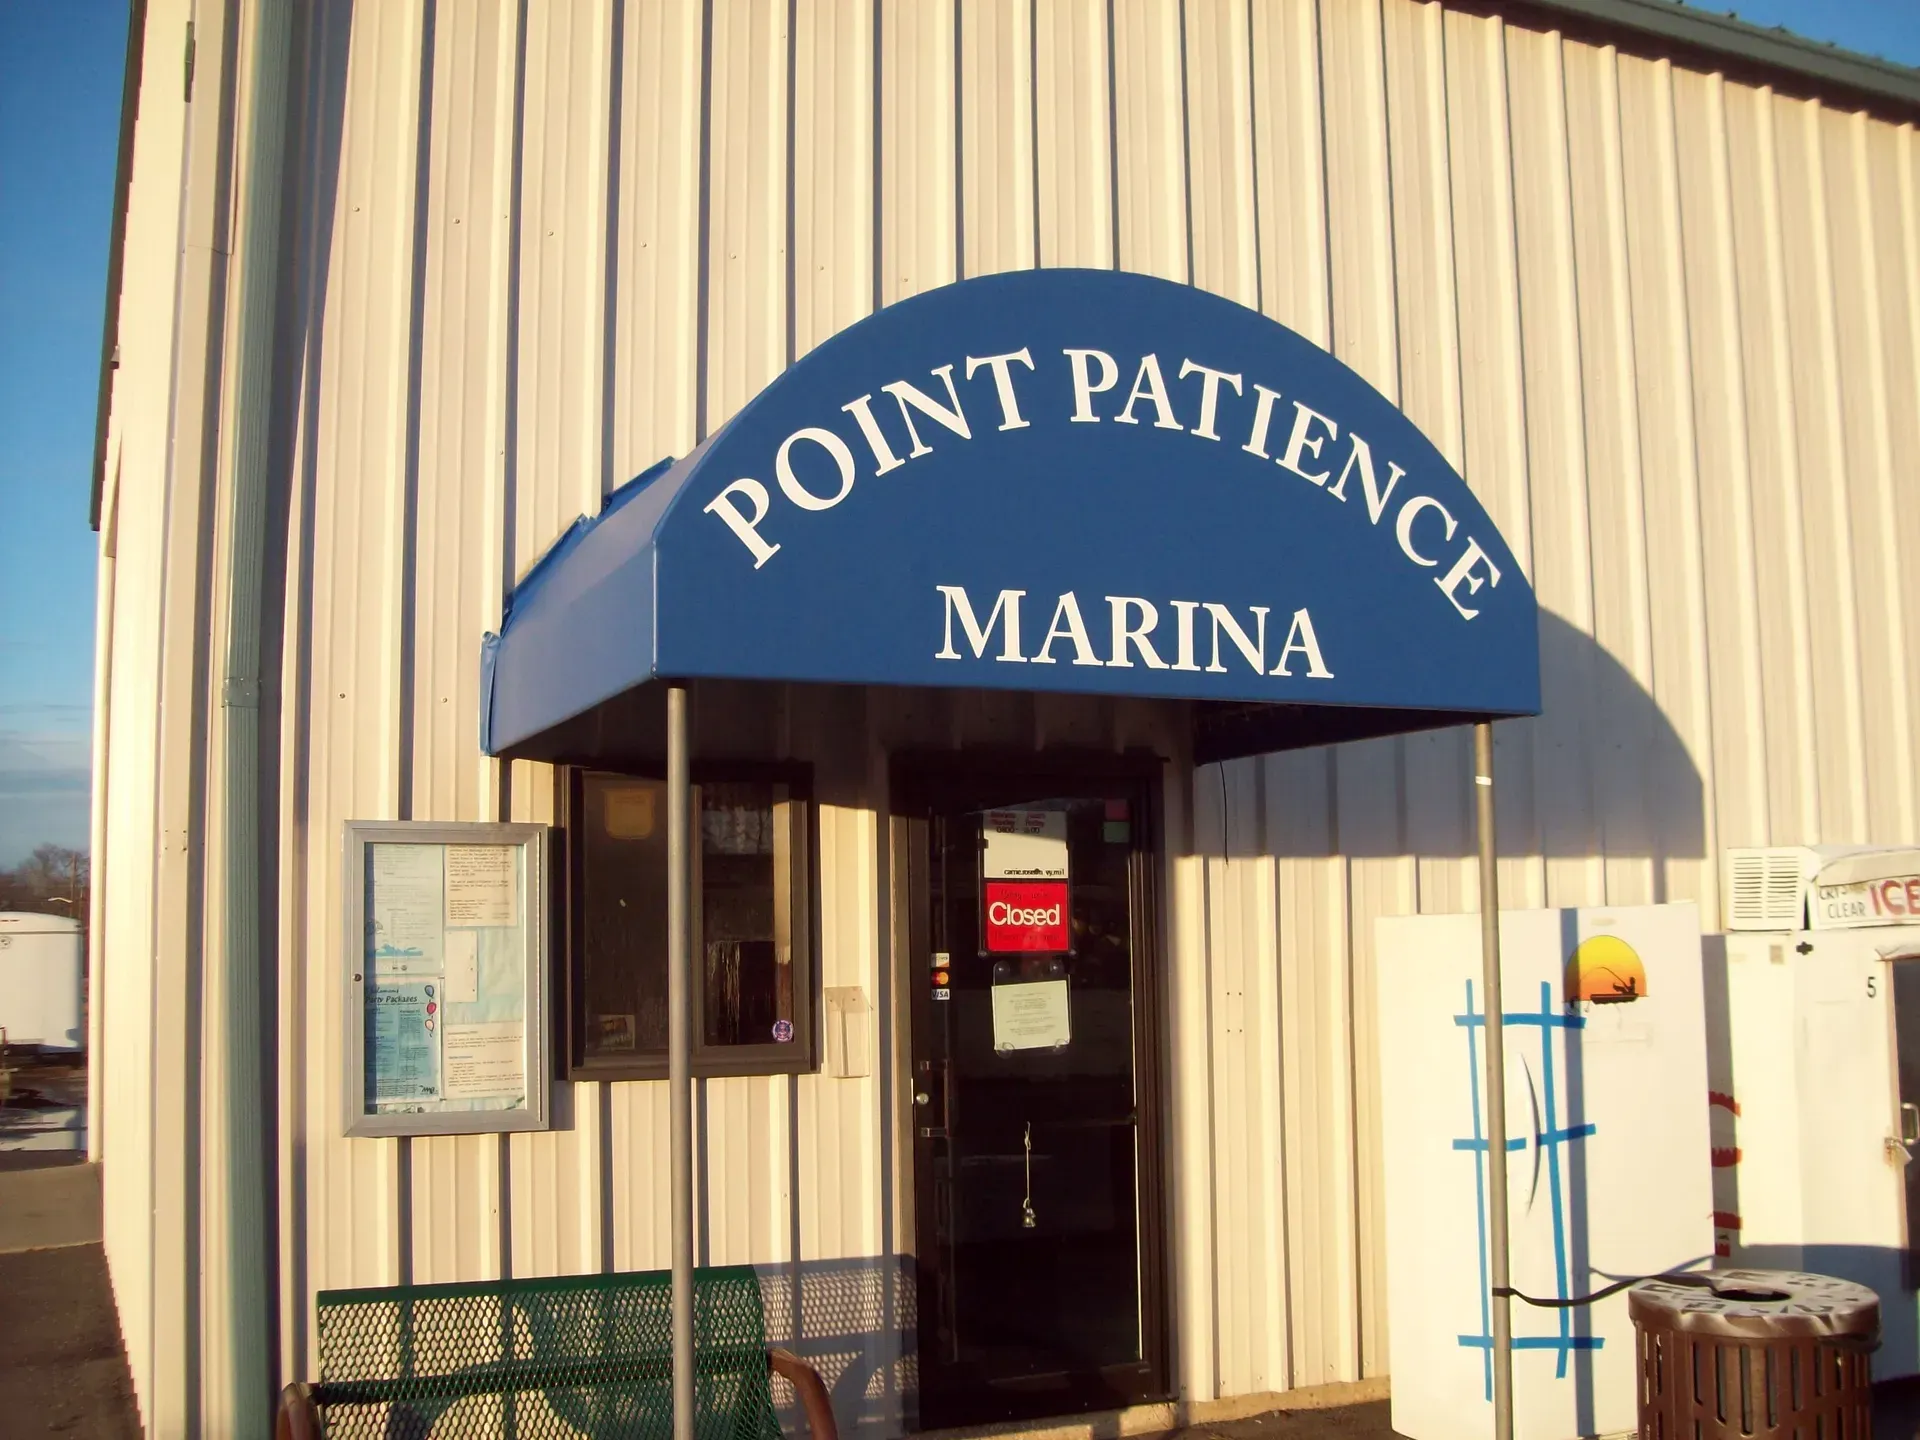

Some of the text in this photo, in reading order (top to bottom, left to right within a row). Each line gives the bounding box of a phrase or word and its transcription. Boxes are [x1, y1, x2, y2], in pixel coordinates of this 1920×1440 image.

[703, 346, 1503, 621] POINT PATIENCE
[934, 585, 1335, 680] MARINA
[989, 901, 1061, 926] Closed
[1828, 879, 1920, 919] CLEAR ICE
[1866, 976, 1877, 999] 5
